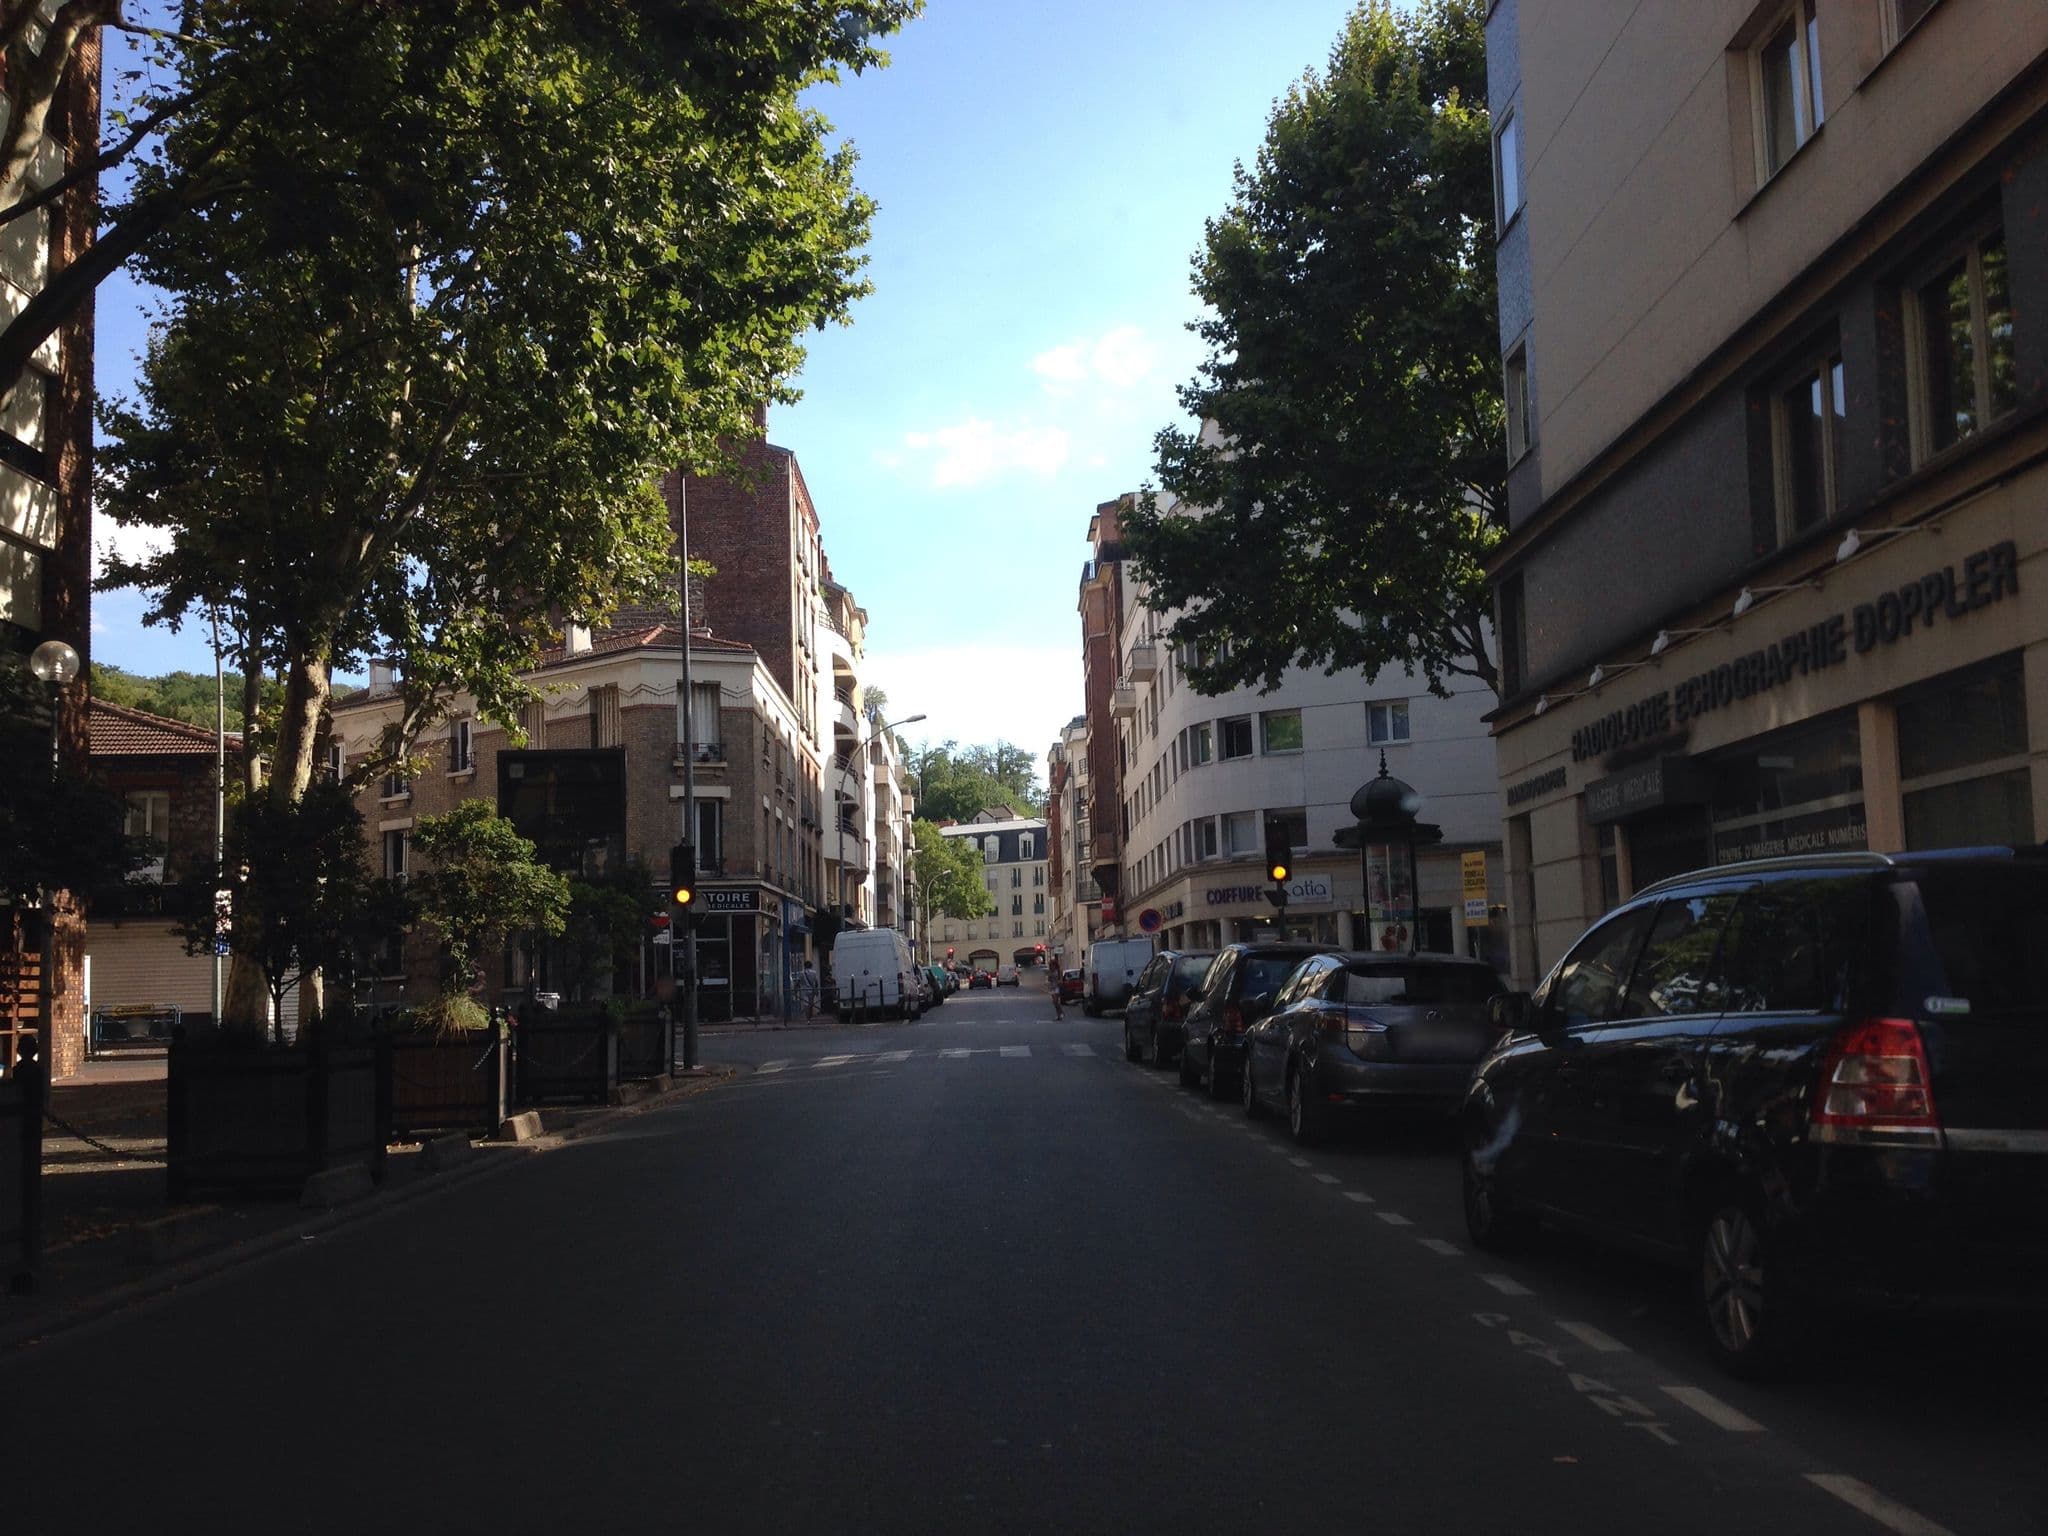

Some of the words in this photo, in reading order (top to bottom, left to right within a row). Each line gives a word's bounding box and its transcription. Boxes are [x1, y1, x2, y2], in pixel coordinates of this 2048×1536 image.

[1674, 612, 1847, 722] ECHOGRAPHIE
[1852, 540, 2019, 653] DOPPLER
[1207, 885, 1263, 905] COIFFURE
[1288, 879, 1327, 898] atia
